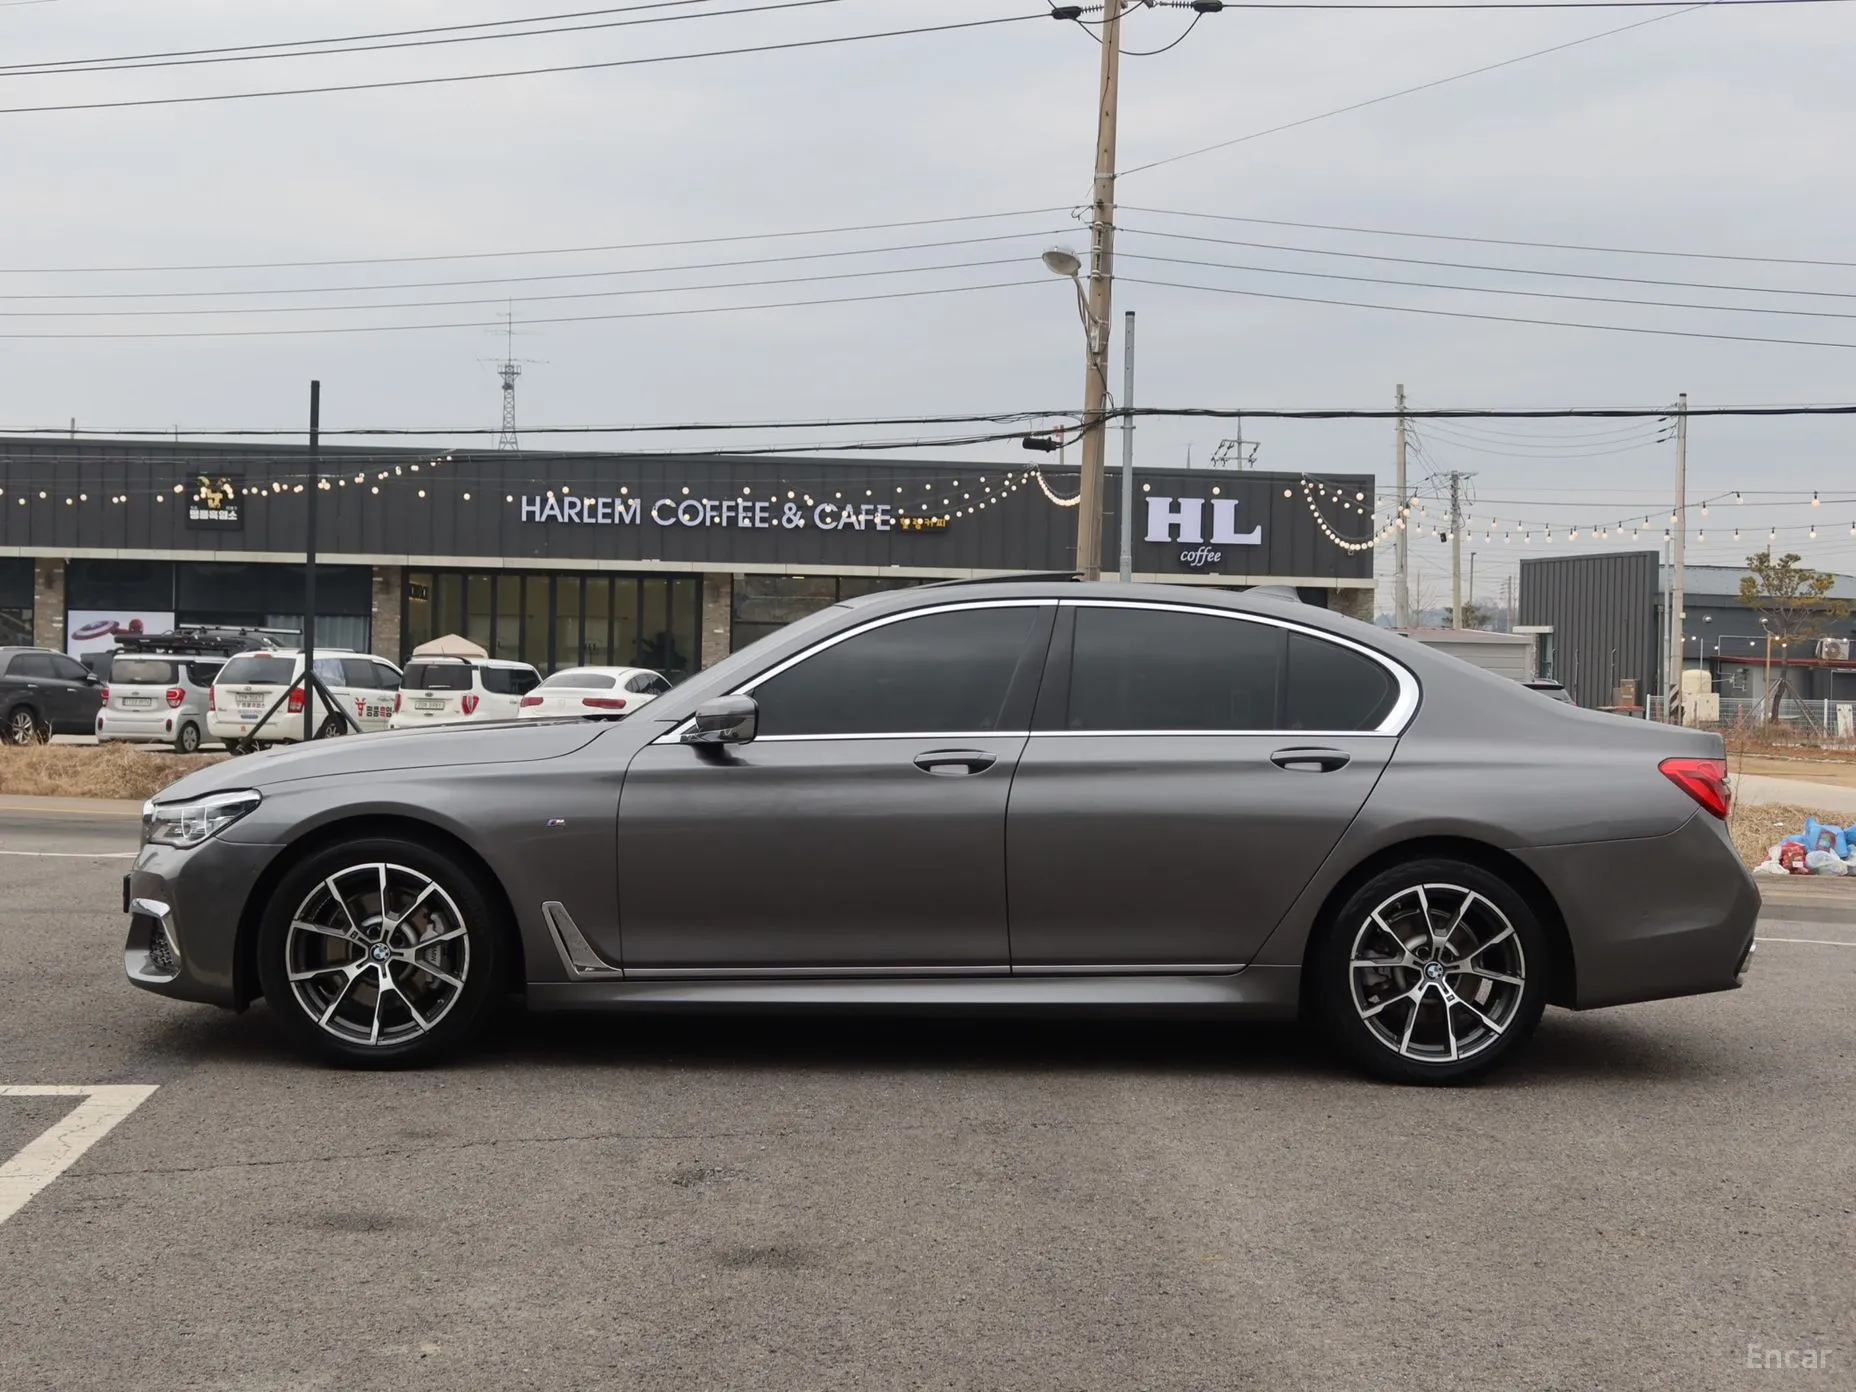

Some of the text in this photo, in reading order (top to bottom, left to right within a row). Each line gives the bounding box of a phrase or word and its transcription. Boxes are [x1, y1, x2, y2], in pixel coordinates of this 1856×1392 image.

[521, 495, 891, 531] HARLEM COFFEE & CAFE
[1145, 496, 1262, 545] HL
[1180, 546, 1222, 567] coffee
